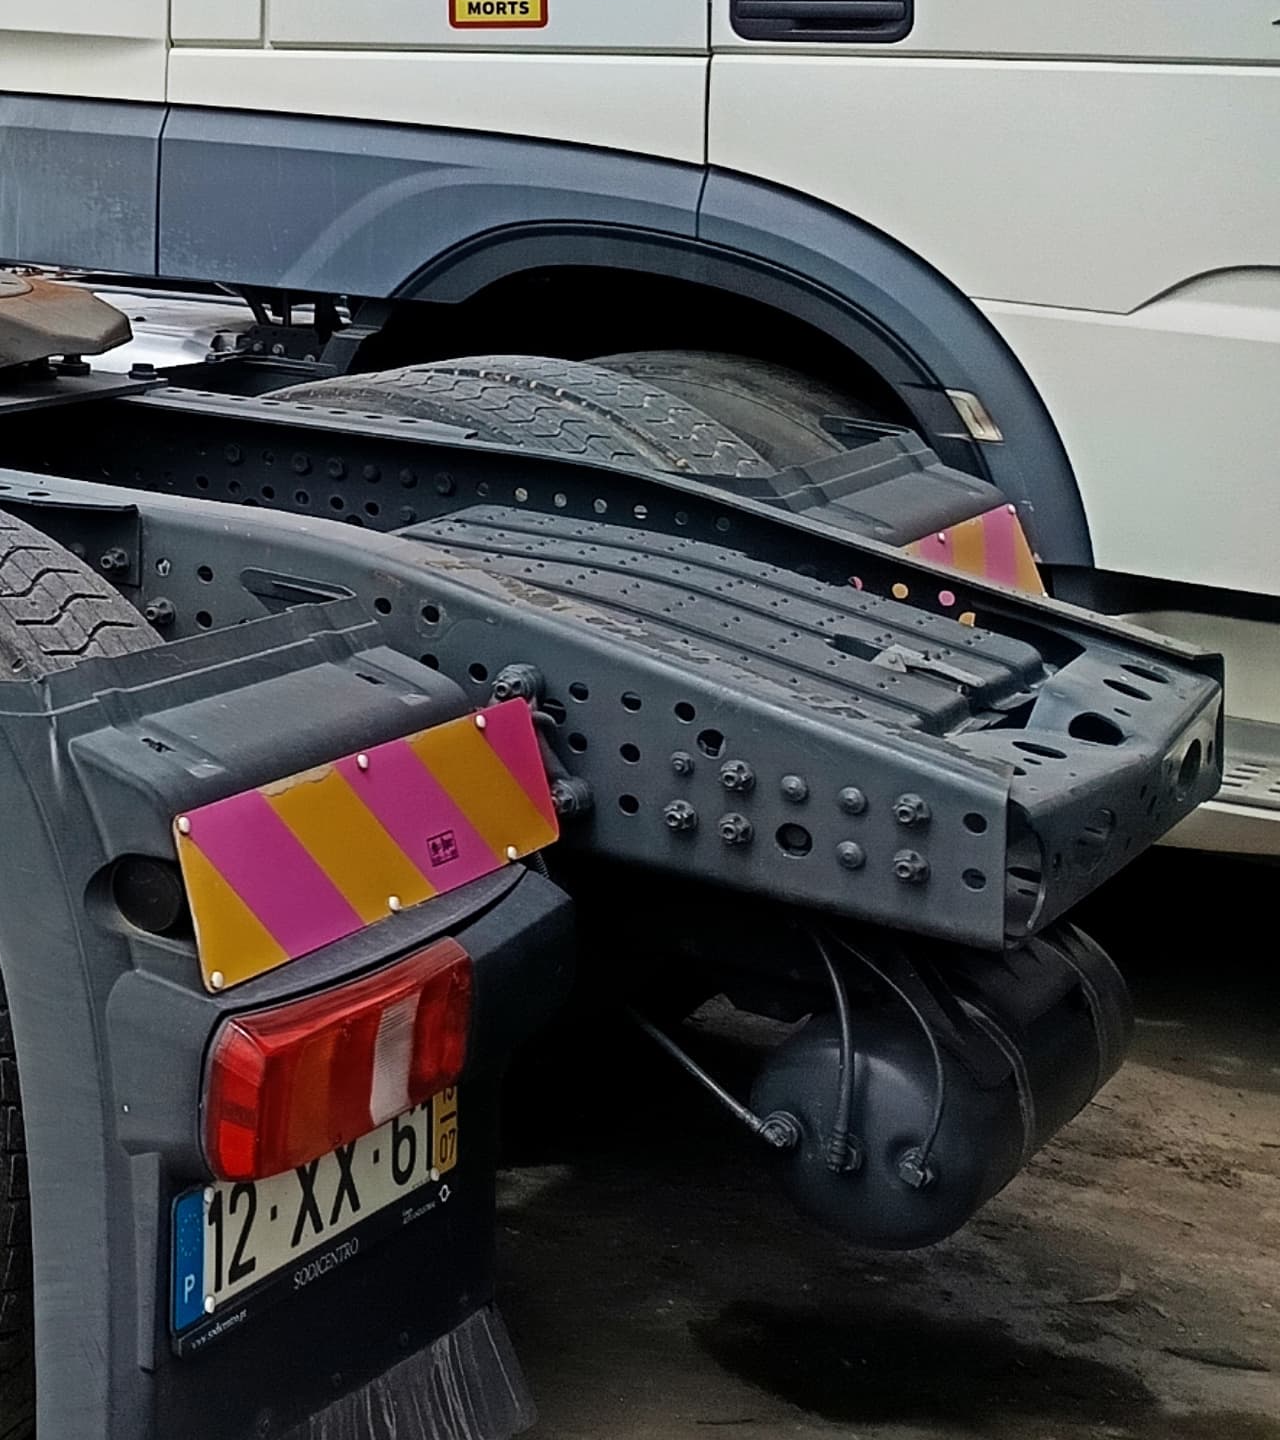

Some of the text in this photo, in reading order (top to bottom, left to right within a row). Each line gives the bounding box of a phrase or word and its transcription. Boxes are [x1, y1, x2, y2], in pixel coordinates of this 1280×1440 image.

[467, 1, 529, 15] MORTS
[440, 1127, 456, 1164] 07
[184, 1274, 196, 1304] P
